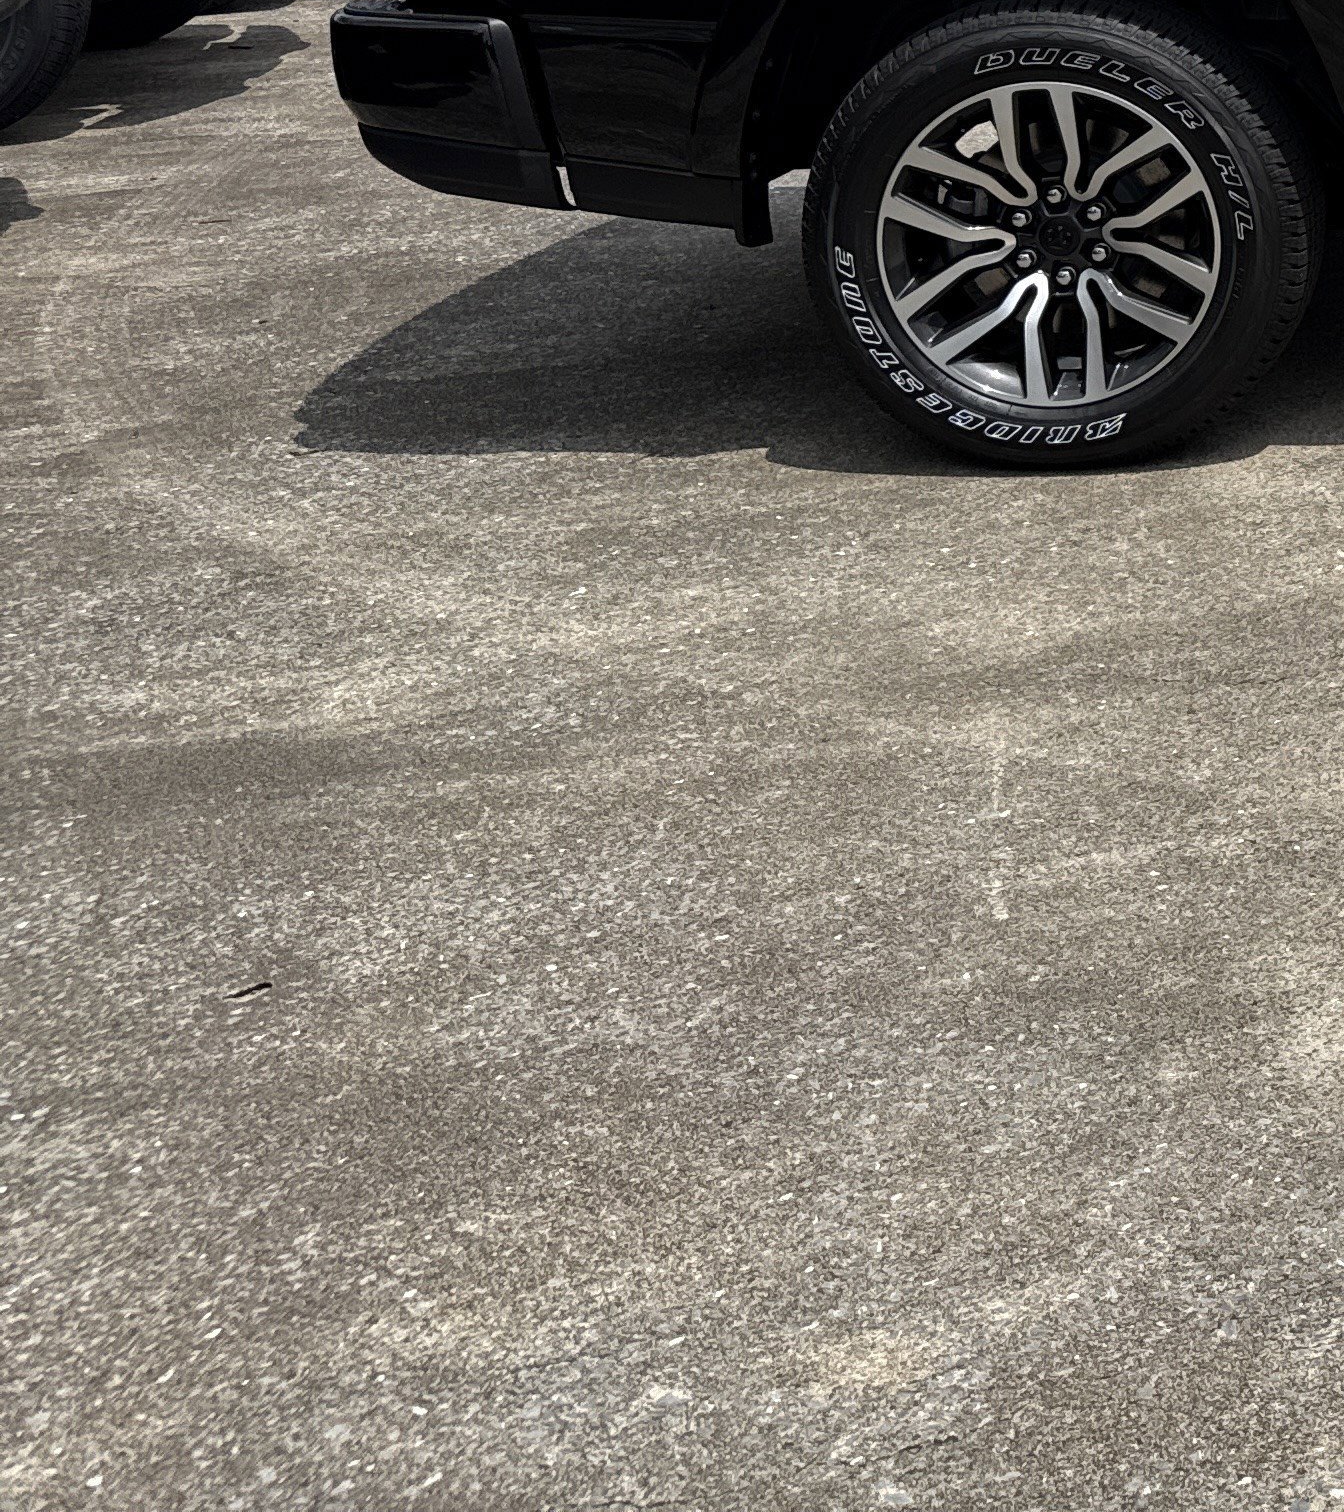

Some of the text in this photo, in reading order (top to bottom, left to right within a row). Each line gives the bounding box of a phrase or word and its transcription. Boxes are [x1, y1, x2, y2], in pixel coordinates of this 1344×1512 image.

[974, 47, 1255, 241] DUELER H/L
[834, 246, 1128, 444] BRIDGESTONE
